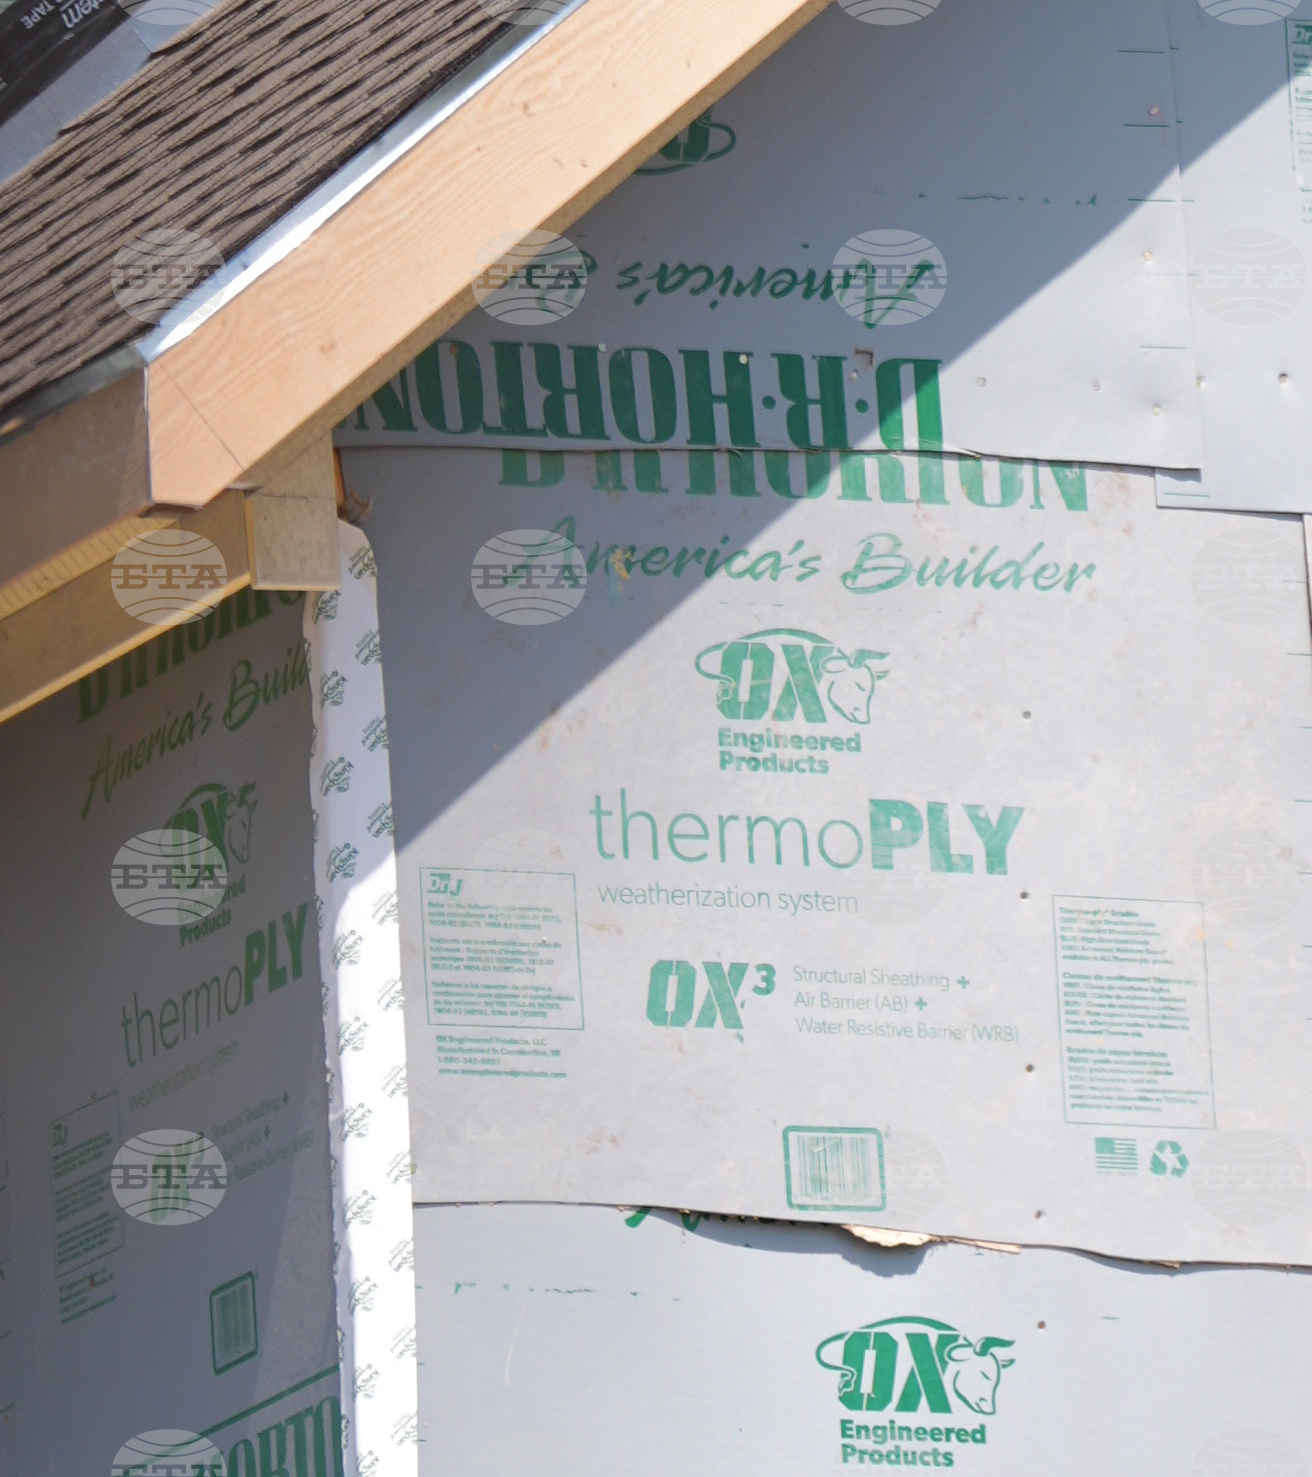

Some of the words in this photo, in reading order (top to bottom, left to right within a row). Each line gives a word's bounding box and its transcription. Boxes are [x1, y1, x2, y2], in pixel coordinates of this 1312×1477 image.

[503, 516, 820, 592] America's
[841, 534, 1095, 595] Builder
[710, 632, 835, 724] OX
[718, 729, 862, 754] Engineered
[590, 789, 1023, 877] thermoPLY
[601, 881, 771, 910] weatherization
[779, 890, 858, 917] system
[839, 1331, 962, 1414] OX
[841, 1419, 986, 1446] Engineered
[842, 1443, 953, 1469] Products
